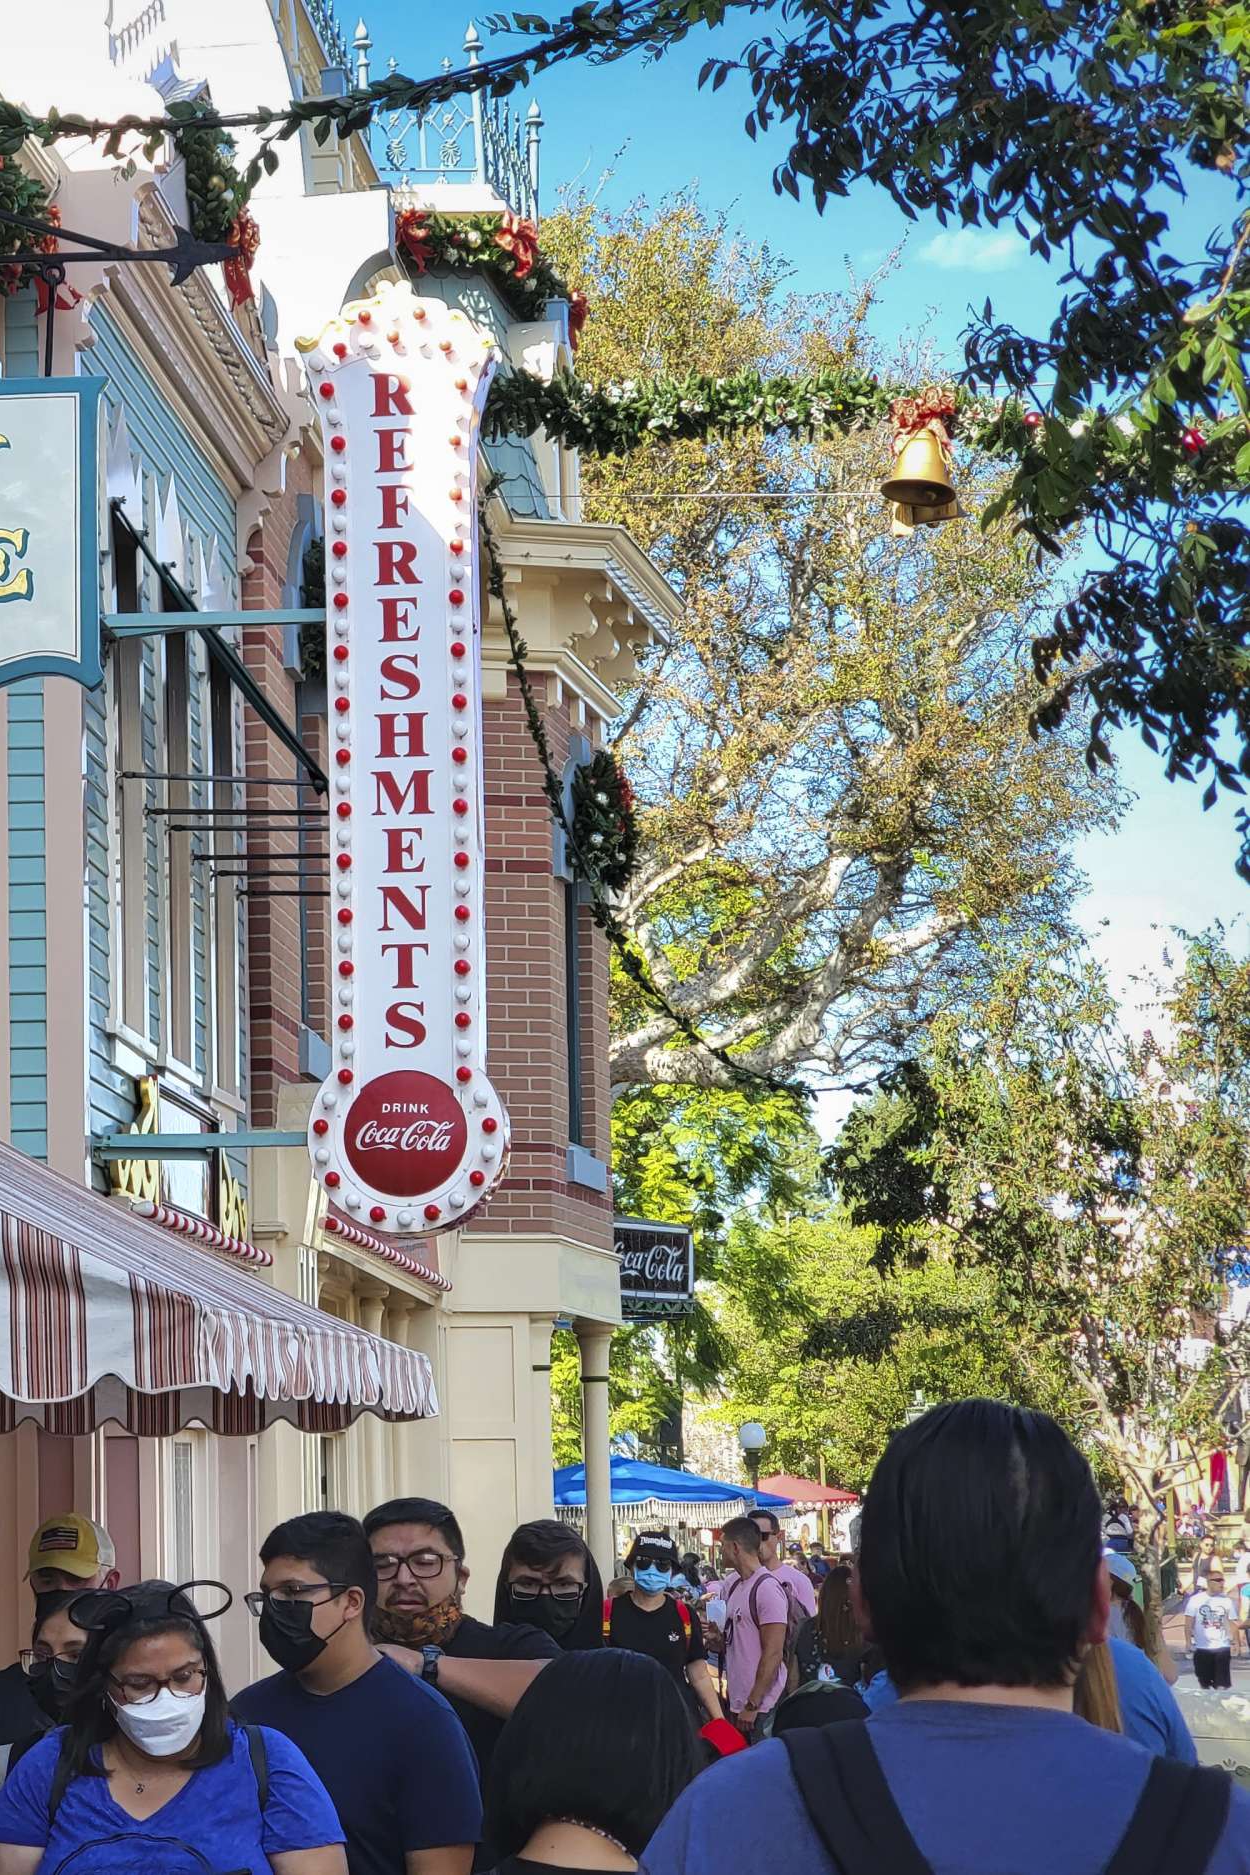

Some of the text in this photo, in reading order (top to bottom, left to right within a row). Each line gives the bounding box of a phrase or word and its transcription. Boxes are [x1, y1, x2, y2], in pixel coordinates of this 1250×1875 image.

[368, 372, 435, 1050] REFRESHMENTS
[381, 1102, 430, 1114] DRINK
[355, 1120, 455, 1151] Coca-Cola
[614, 1241, 684, 1282] ca-Cola
